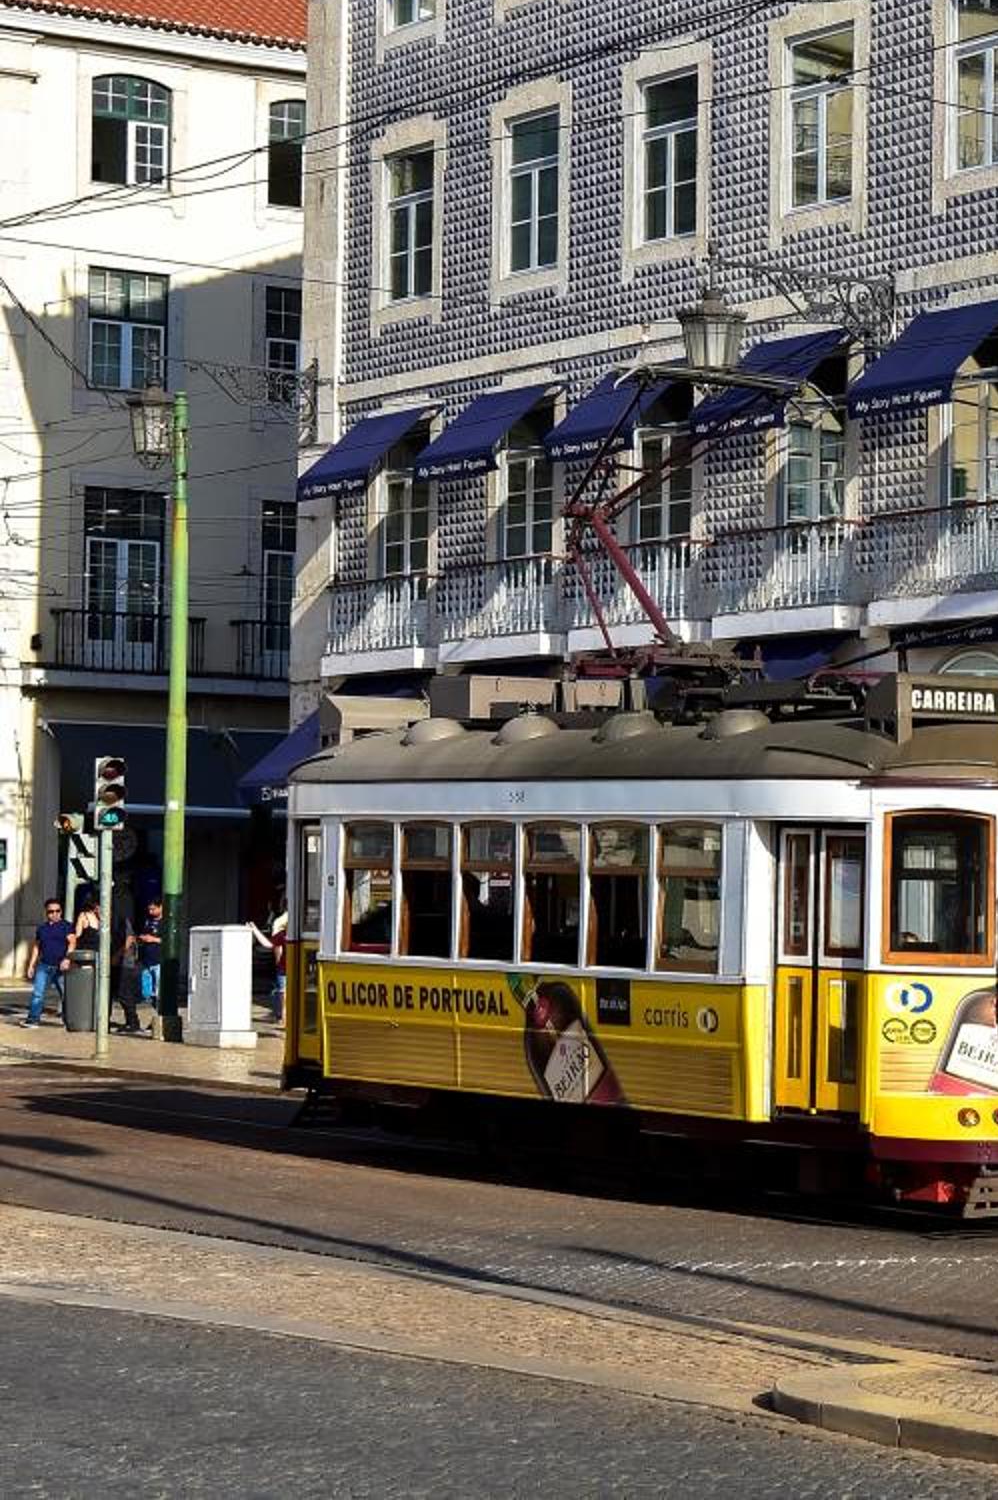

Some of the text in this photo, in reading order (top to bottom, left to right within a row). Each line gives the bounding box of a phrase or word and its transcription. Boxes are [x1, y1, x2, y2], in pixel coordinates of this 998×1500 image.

[855, 401, 869, 412] My
[871, 397, 890, 409] Story
[892, 393, 911, 405] Hotel
[551, 446, 562, 457] My
[563, 443, 580, 455] Story
[418, 467, 429, 478] My
[911, 689, 995, 713] CARREIRA
[327, 981, 510, 1016] O LICOR DE PORTUGAL
[643, 1001, 689, 1028] carris
